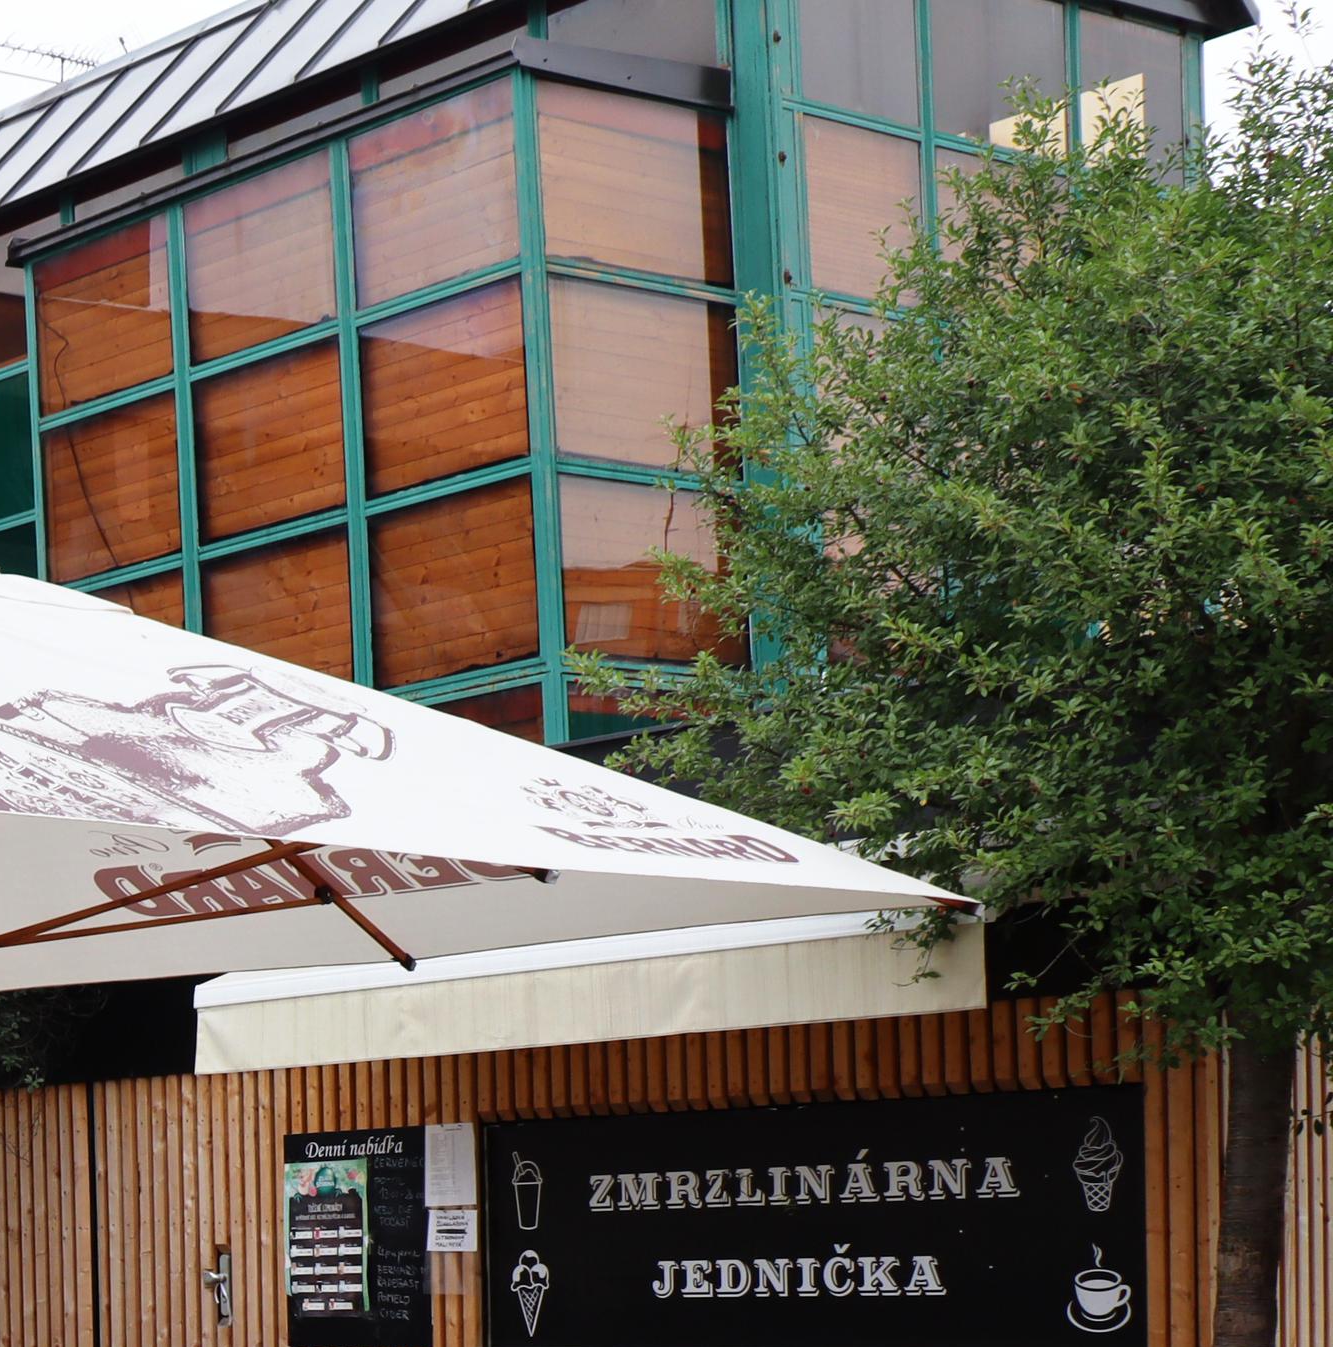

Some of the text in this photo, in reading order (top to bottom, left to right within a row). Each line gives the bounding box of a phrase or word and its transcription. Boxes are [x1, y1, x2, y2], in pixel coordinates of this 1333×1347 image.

[531, 824, 800, 863] BERNARD
[305, 1134, 404, 1159] Denní nabídka
[589, 1148, 1020, 1212] ZMRZLINÁRNA
[652, 1243, 947, 1298] JEDNIČKA
